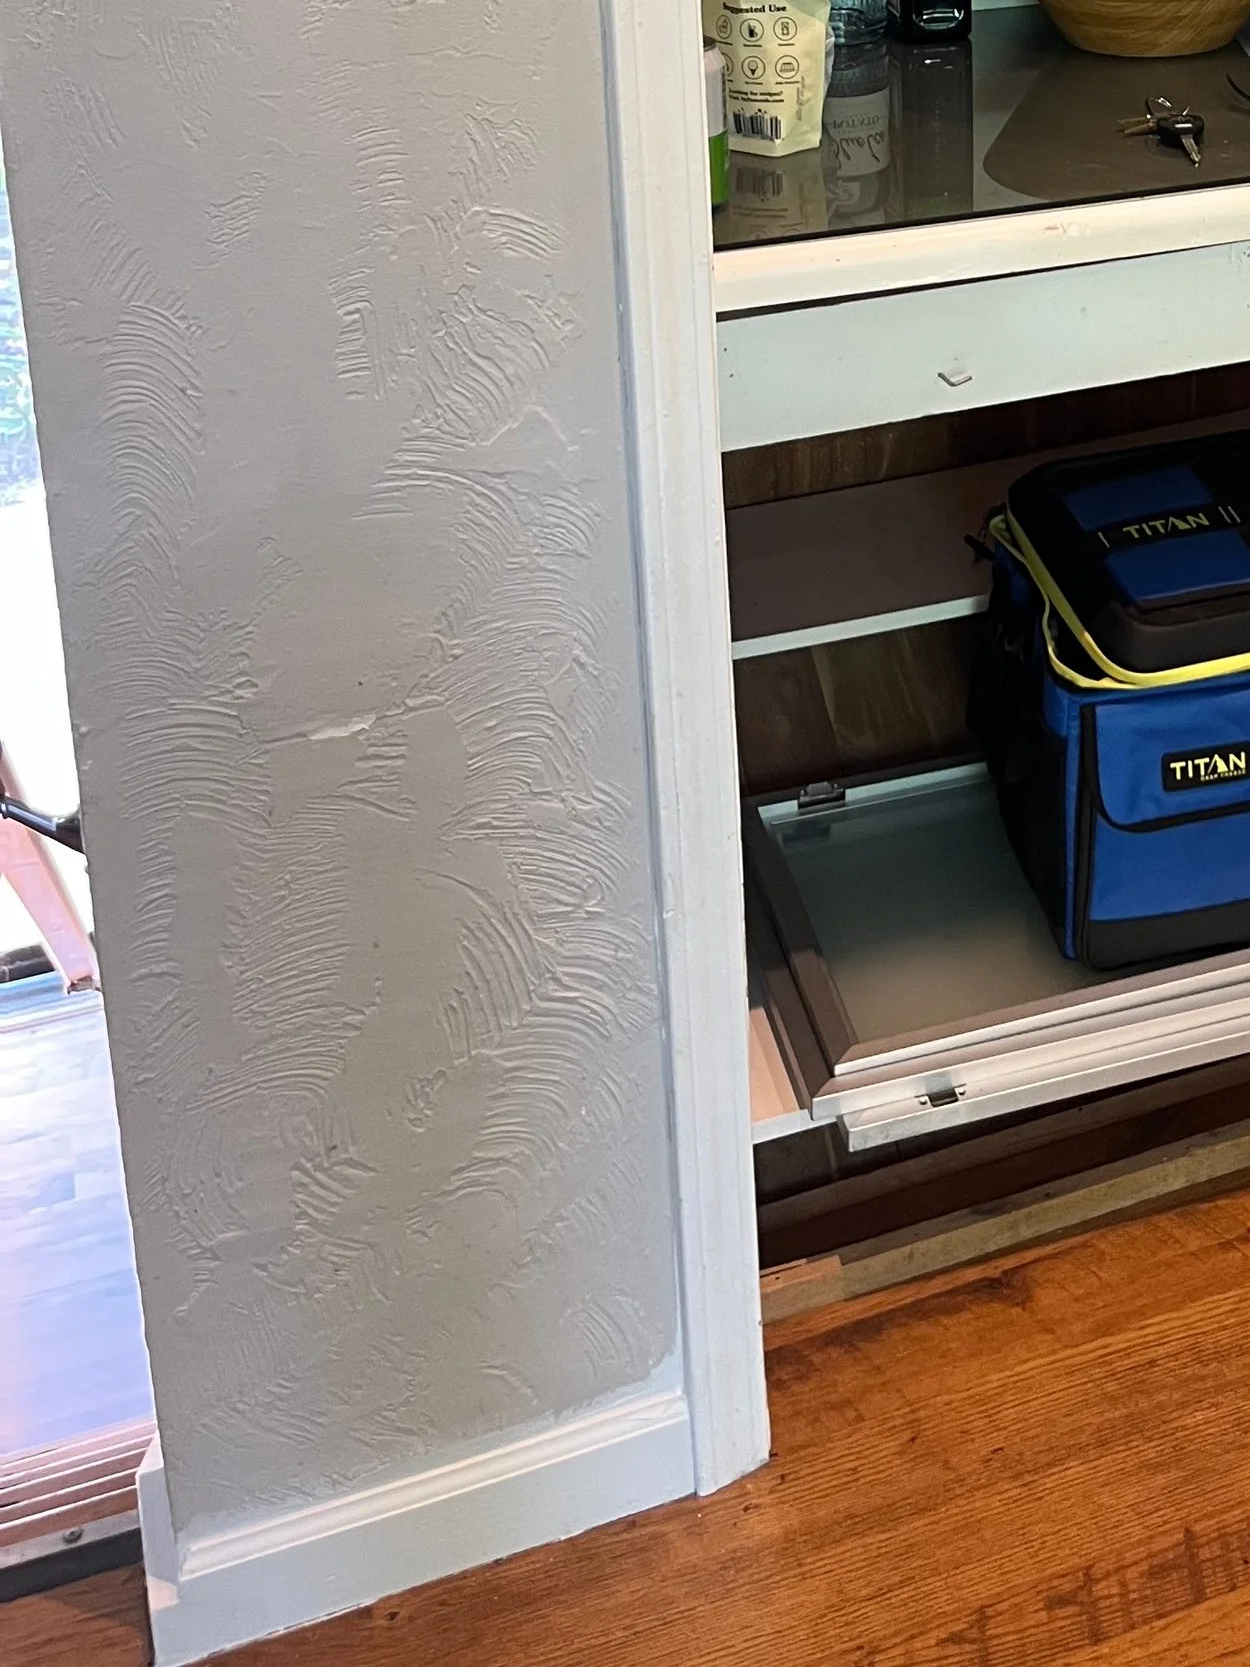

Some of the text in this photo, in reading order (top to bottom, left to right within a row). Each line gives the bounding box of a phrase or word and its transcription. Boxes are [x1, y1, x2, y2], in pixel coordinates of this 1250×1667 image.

[768, 4, 787, 13] Use
[1123, 512, 1210, 539] TITAN
[1169, 751, 1246, 780] TITAN
